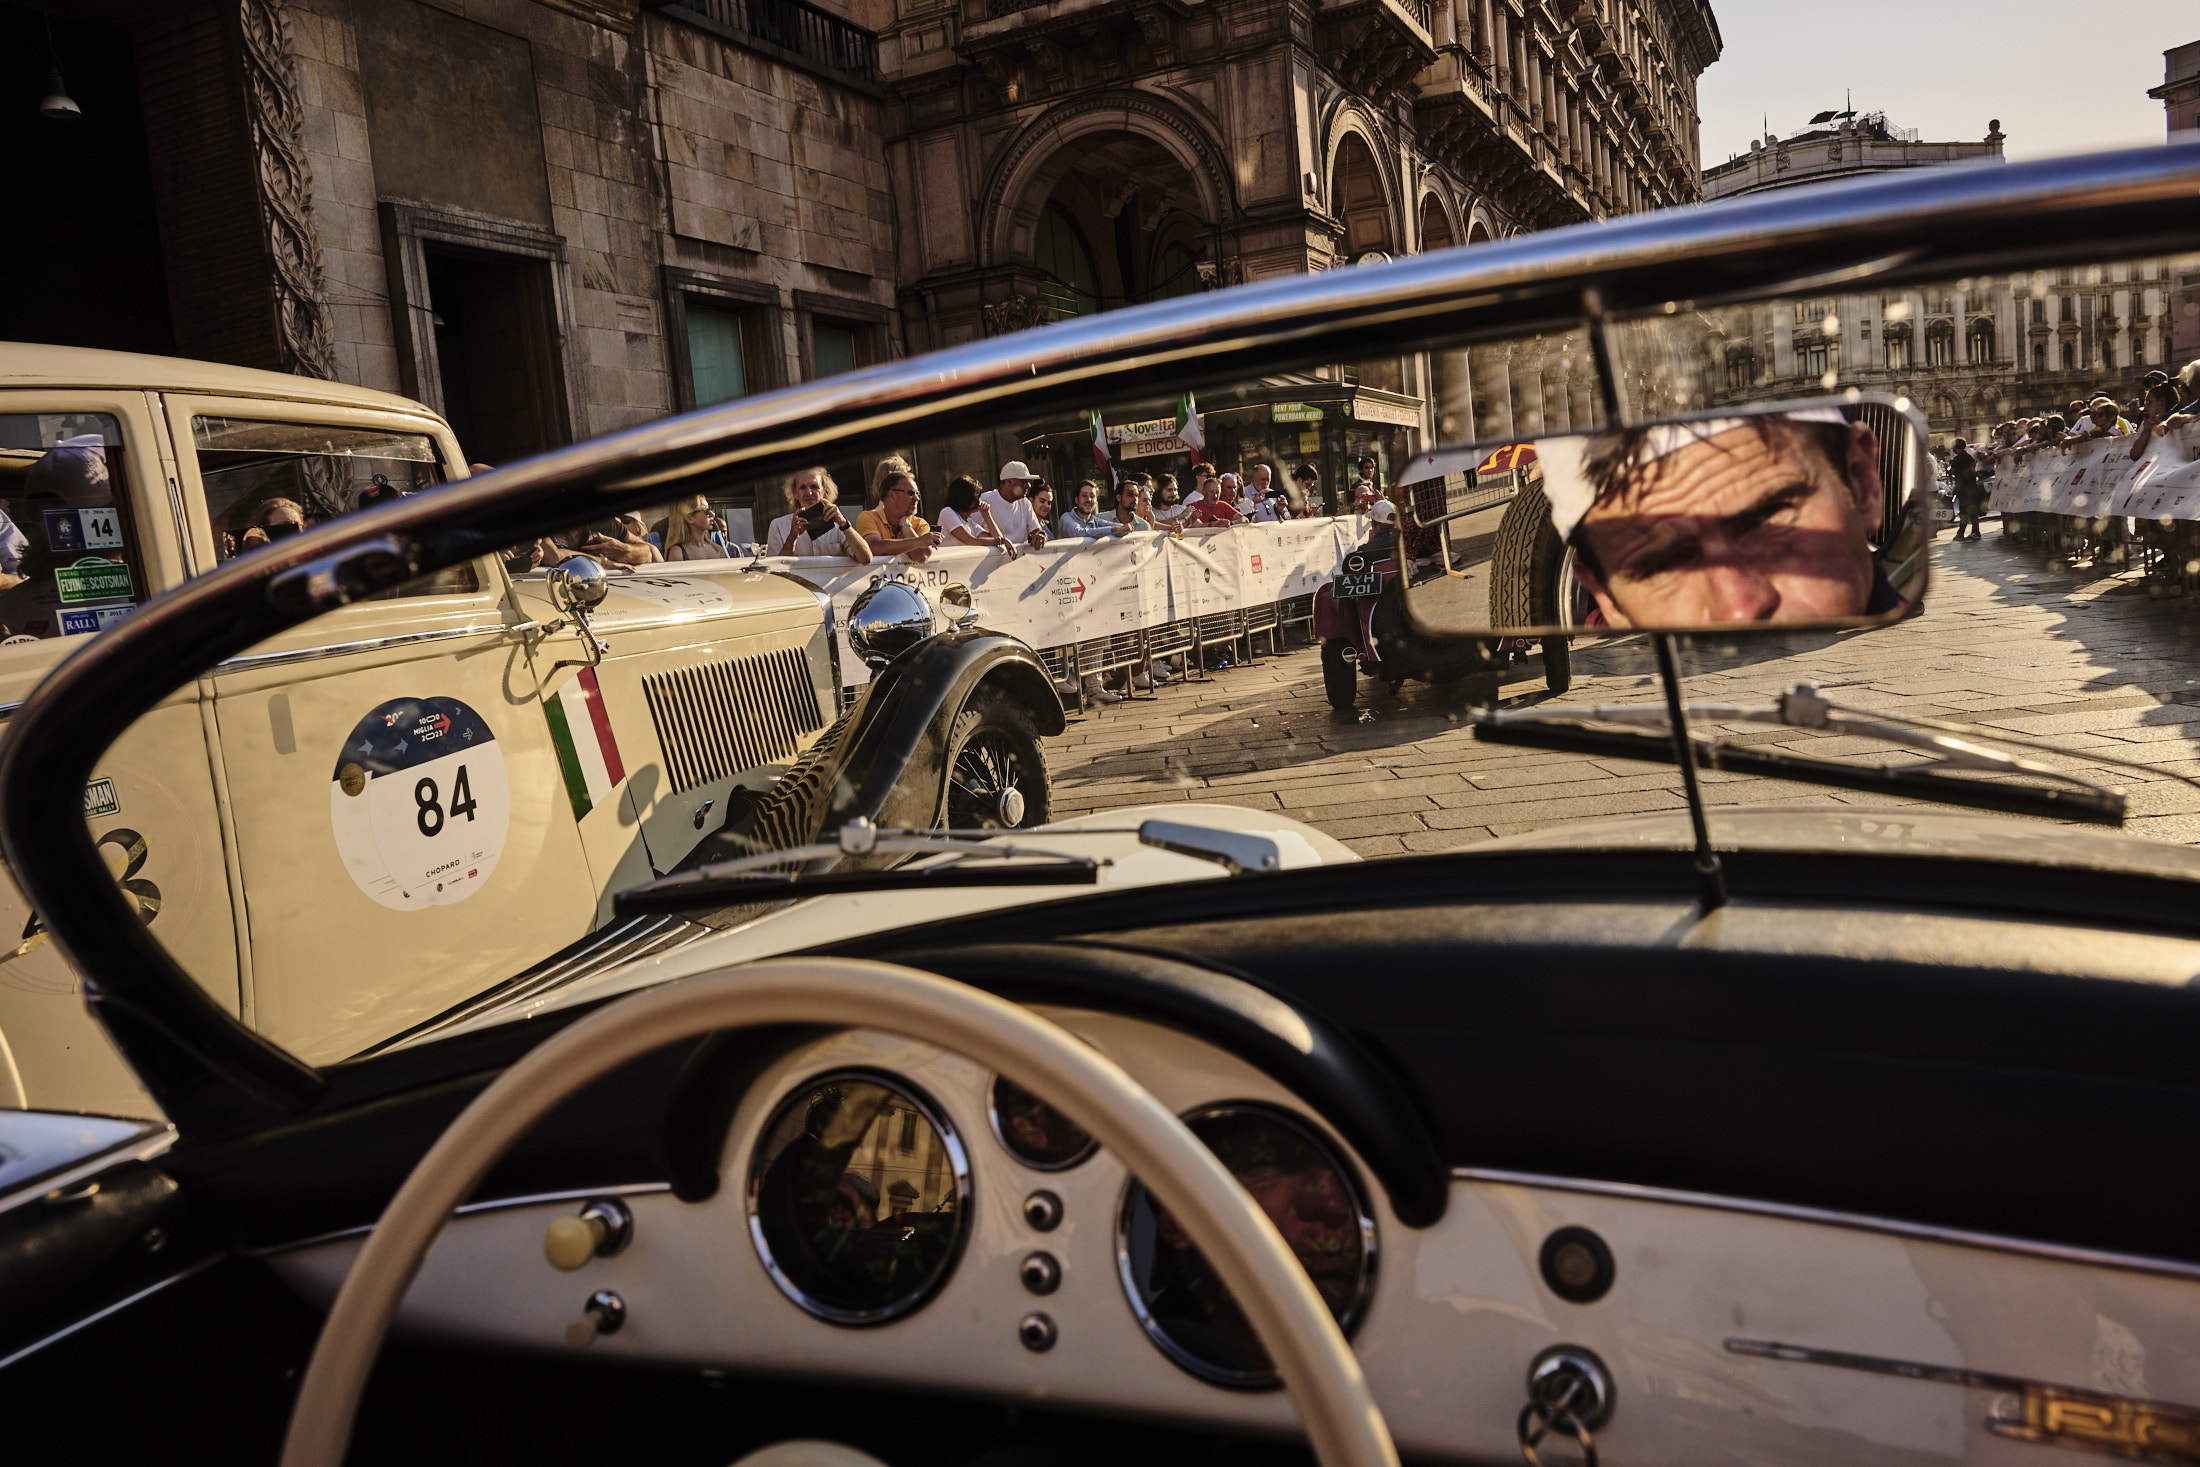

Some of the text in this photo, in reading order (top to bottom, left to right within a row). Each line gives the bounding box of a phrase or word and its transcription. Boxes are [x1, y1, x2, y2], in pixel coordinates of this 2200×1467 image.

[1274, 403, 1301, 412] RENT YOUR
[1275, 411, 1321, 421] POWERBANK HERE!
[1137, 440, 1190, 454] EDICOLA
[91, 518, 113, 537] 14
[60, 578, 86, 592] FLYING
[89, 574, 129, 590] SCOTSMAN
[1342, 575, 1375, 585] AYH
[1052, 587, 1070, 596] MIGLIA
[1344, 585, 1371, 595] 701
[66, 618, 96, 630] RALLY
[386, 711, 404, 726] 20
[419, 714, 440, 725] 1000
[413, 724, 434, 736] MIGLIA
[422, 730, 443, 742] 2023
[415, 764, 477, 837] 84
[426, 860, 460, 877] CHOPARD
